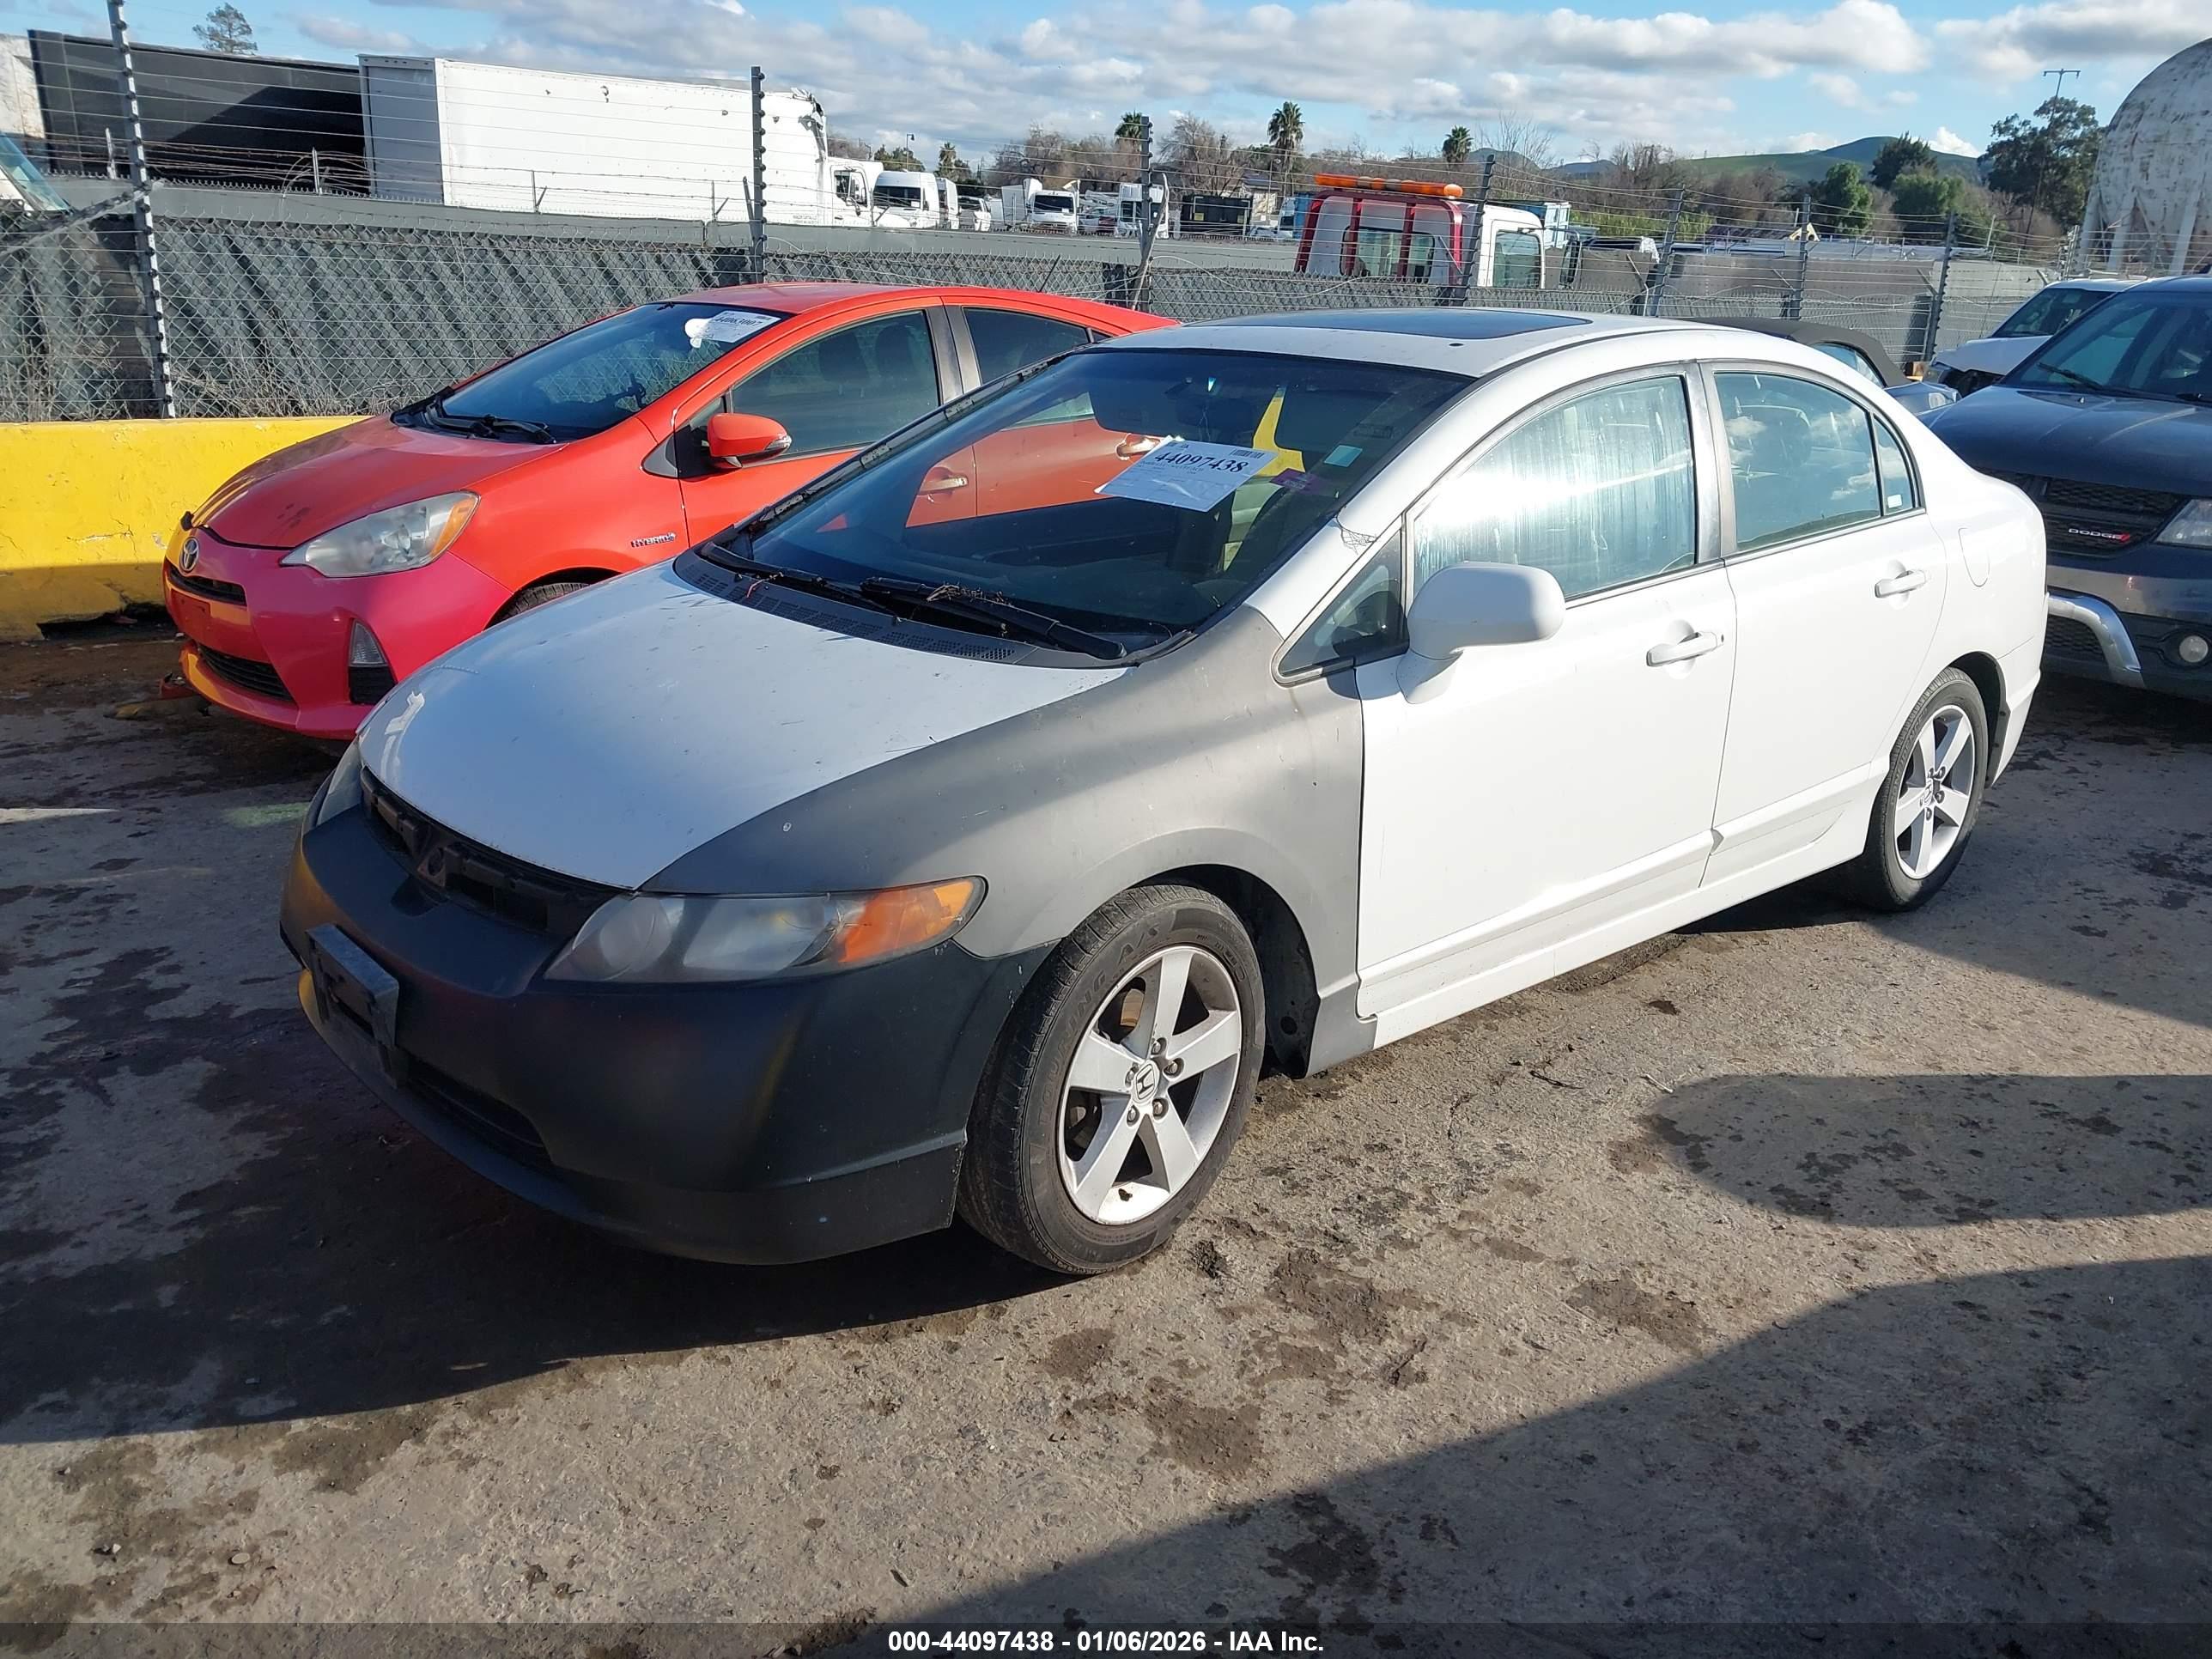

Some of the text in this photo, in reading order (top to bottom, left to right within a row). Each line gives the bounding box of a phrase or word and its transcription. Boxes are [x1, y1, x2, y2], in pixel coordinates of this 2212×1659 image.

[1154, 452, 1249, 473] 44097438
[2068, 528, 2123, 540] DODGE
[1038, 969, 1107, 1126] TOURING
